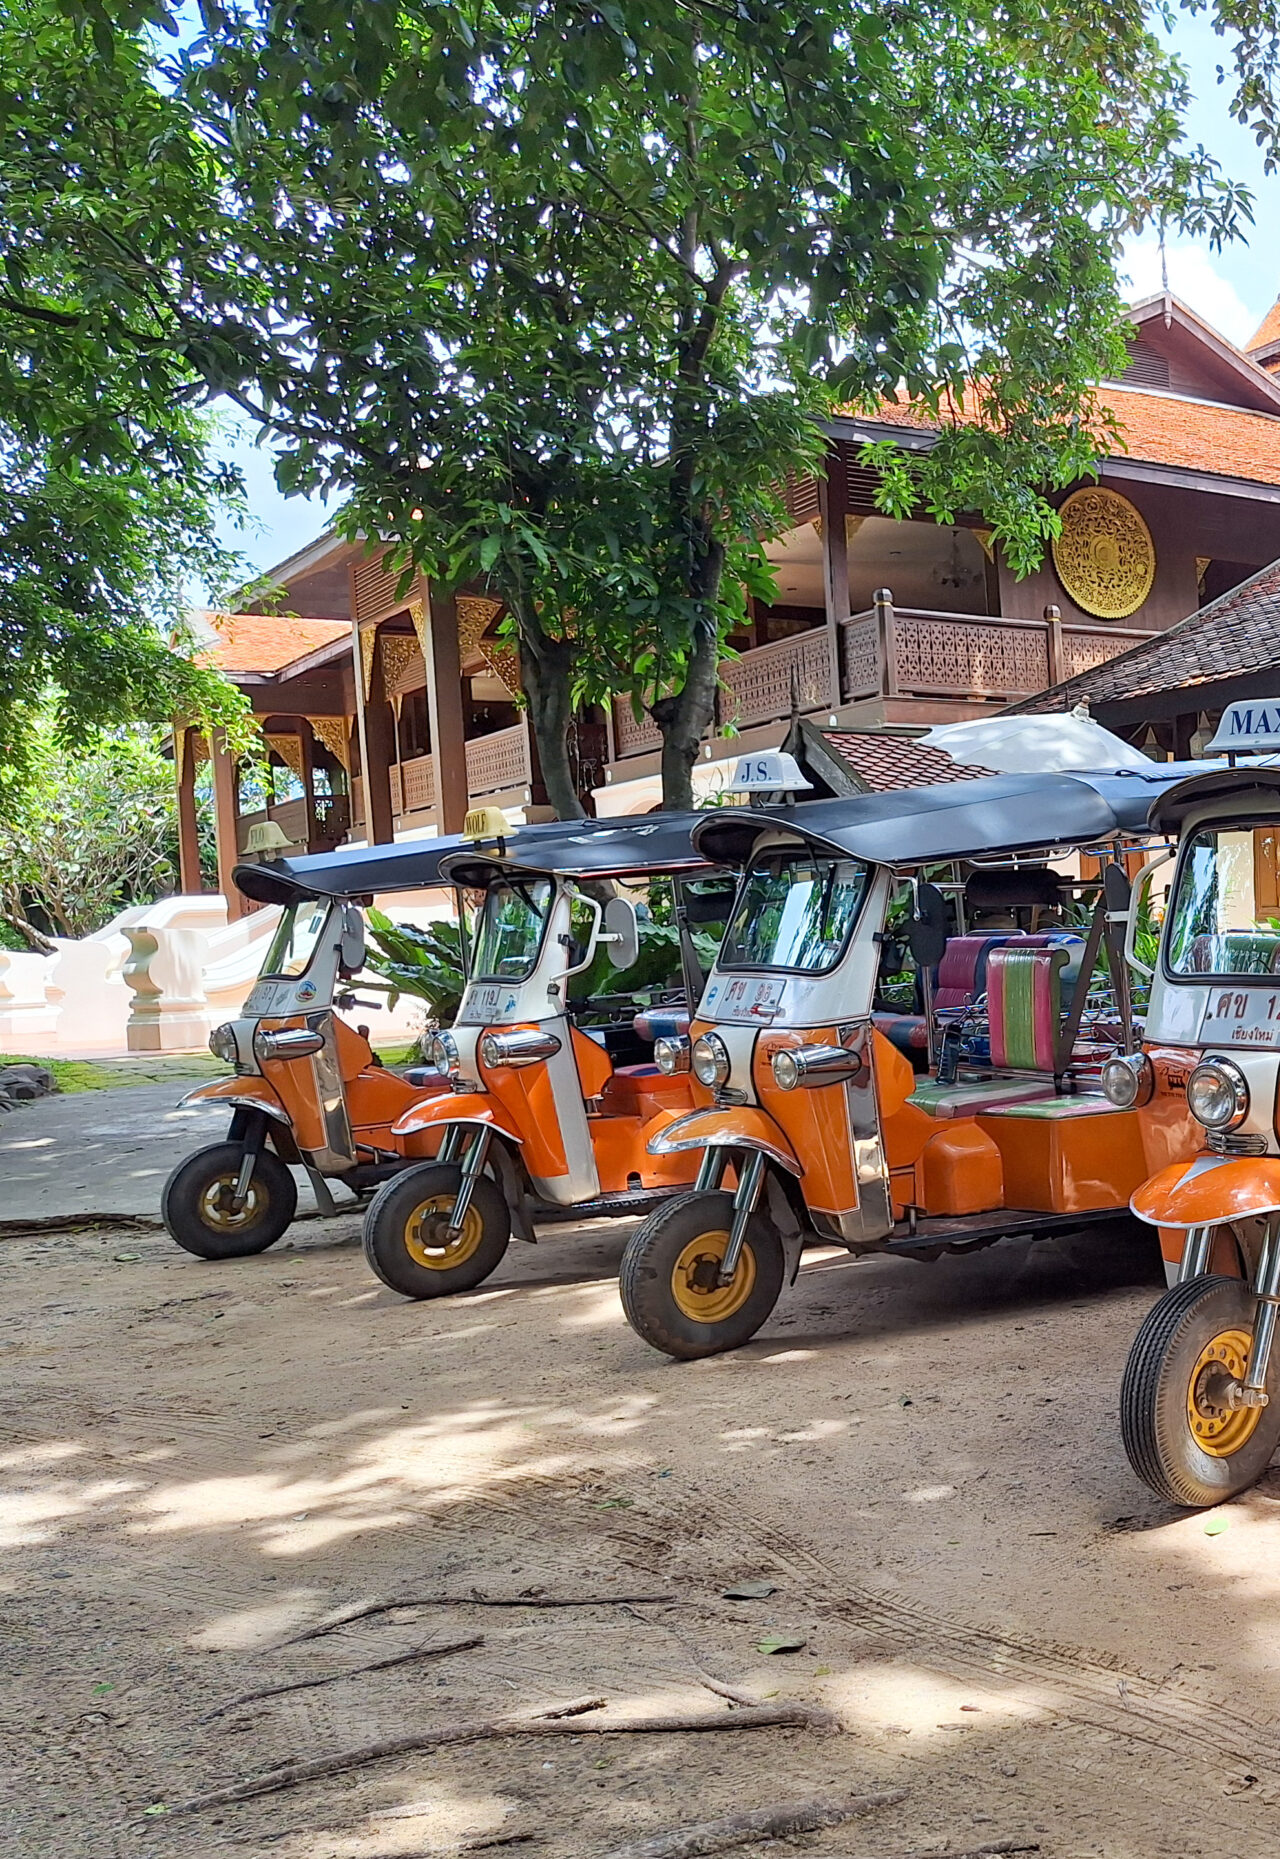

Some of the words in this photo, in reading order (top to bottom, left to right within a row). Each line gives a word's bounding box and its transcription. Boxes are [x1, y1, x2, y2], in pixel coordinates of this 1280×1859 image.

[741, 761, 772, 782] J.S.
[466, 813, 486, 835] WOLF
[250, 828, 265, 846] FLO
[1216, 992, 1248, 1018] ศข
[1231, 1025, 1275, 1042] เชียงใหม่
